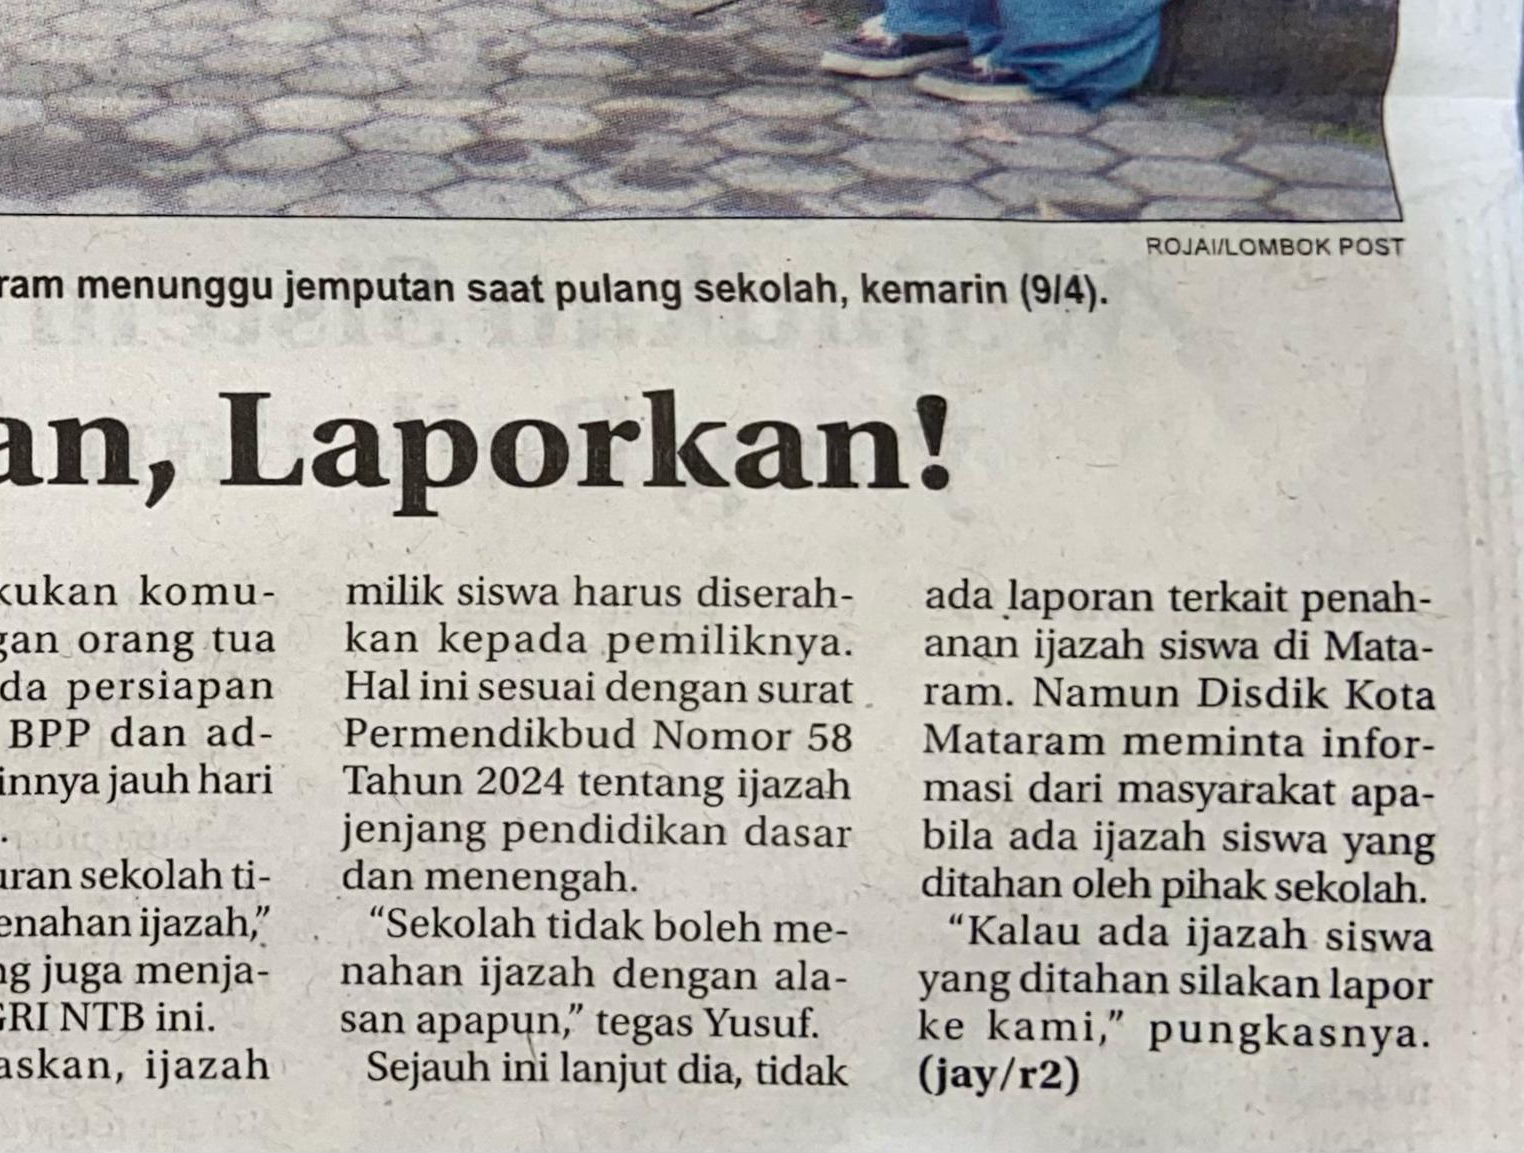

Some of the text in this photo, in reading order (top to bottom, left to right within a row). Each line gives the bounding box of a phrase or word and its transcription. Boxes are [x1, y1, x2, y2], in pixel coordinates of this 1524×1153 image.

[1146, 237, 1406, 257] ROJAI/LOMBOK POST
[77, 275, 273, 309] menunggu
[283, 269, 455, 310] jemputan
[467, 273, 546, 304] saat
[555, 272, 682, 312] pulang
[693, 271, 848, 310] sekolah,
[860, 272, 1008, 305] kemarin
[1020, 272, 1108, 314] (9/4).
[217, 388, 951, 518] Laporkan!
[138, 573, 275, 607] komu-
[345, 573, 854, 609] milik siswa harus diserah-
[77, 630, 195, 663] orang
[211, 626, 276, 654] tua
[923, 675, 1437, 711] ram. Namun Disdik Kota
[7, 717, 91, 749] BPP
[110, 715, 187, 748] dan
[206, 715, 273, 748] ad-
[344, 716, 853, 753] Permendikbud Nomor 58
[922, 722, 1435, 760] Mataram meminta infor-
[342, 763, 852, 809] Tahun 2024 tentang ijazah
[923, 770, 1435, 817] masi dari masyarakat apa-
[339, 811, 853, 853] jenjang pendidikan dasar
[80, 857, 224, 891] sekolah
[231, 859, 271, 891] ti-
[921, 865, 1427, 909] ditahan oleh pihak sekolah.
[546, 907, 645, 942] tidak
[653, 908, 763, 943] boleh
[773, 920, 849, 944] me-
[1098, 913, 1170, 947] ada
[1186, 916, 1309, 957] ijazah
[1325, 920, 1435, 954] siswa
[40, 953, 123, 995] juga
[134, 954, 270, 994] menja-
[340, 953, 848, 1000] nahan ijazah dengan ala-
[917, 960, 1434, 1010] yang ditahan silakan lapor
[59, 1001, 145, 1033] NTB
[155, 1001, 215, 1033] ini.
[918, 1008, 964, 1041] ke
[1148, 1012, 1430, 1058] pungkasnya.
[367, 1049, 849, 1094] Sejauh ini lanjut dia, tidak
[918, 1053, 1080, 1098] (jay/r2)
